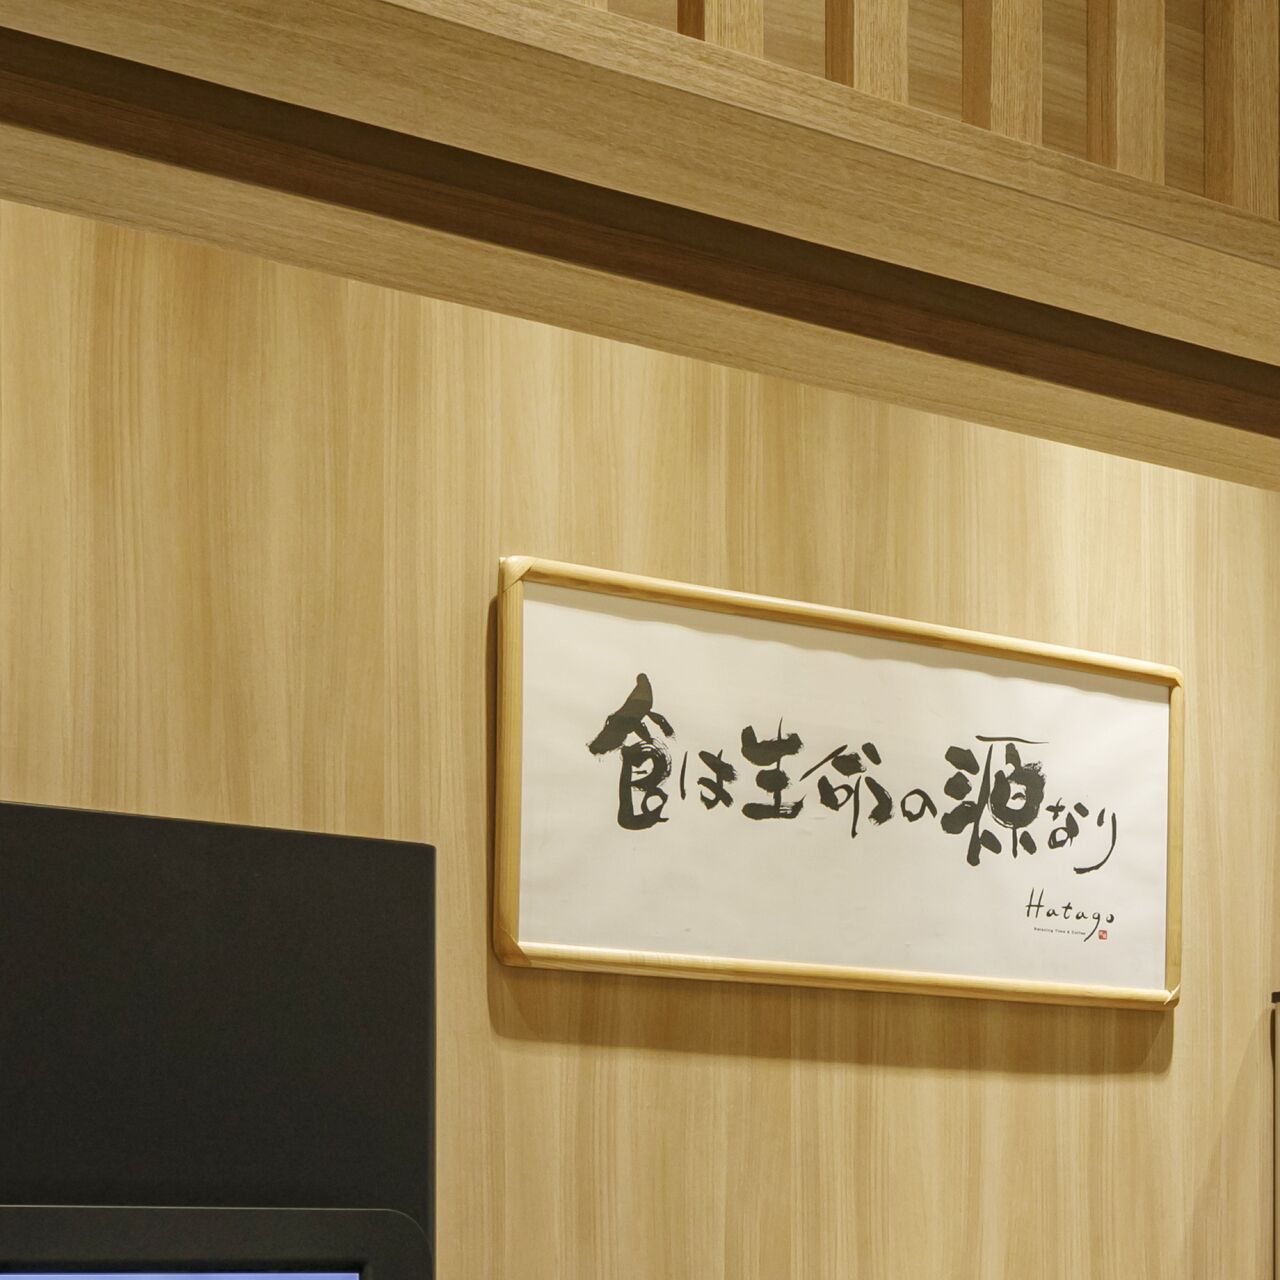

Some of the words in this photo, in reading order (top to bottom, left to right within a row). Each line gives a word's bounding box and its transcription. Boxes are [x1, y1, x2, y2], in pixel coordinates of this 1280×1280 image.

[586, 672, 1118, 875] 食は生命の源なり
[1025, 887, 1115, 942] Hatago
